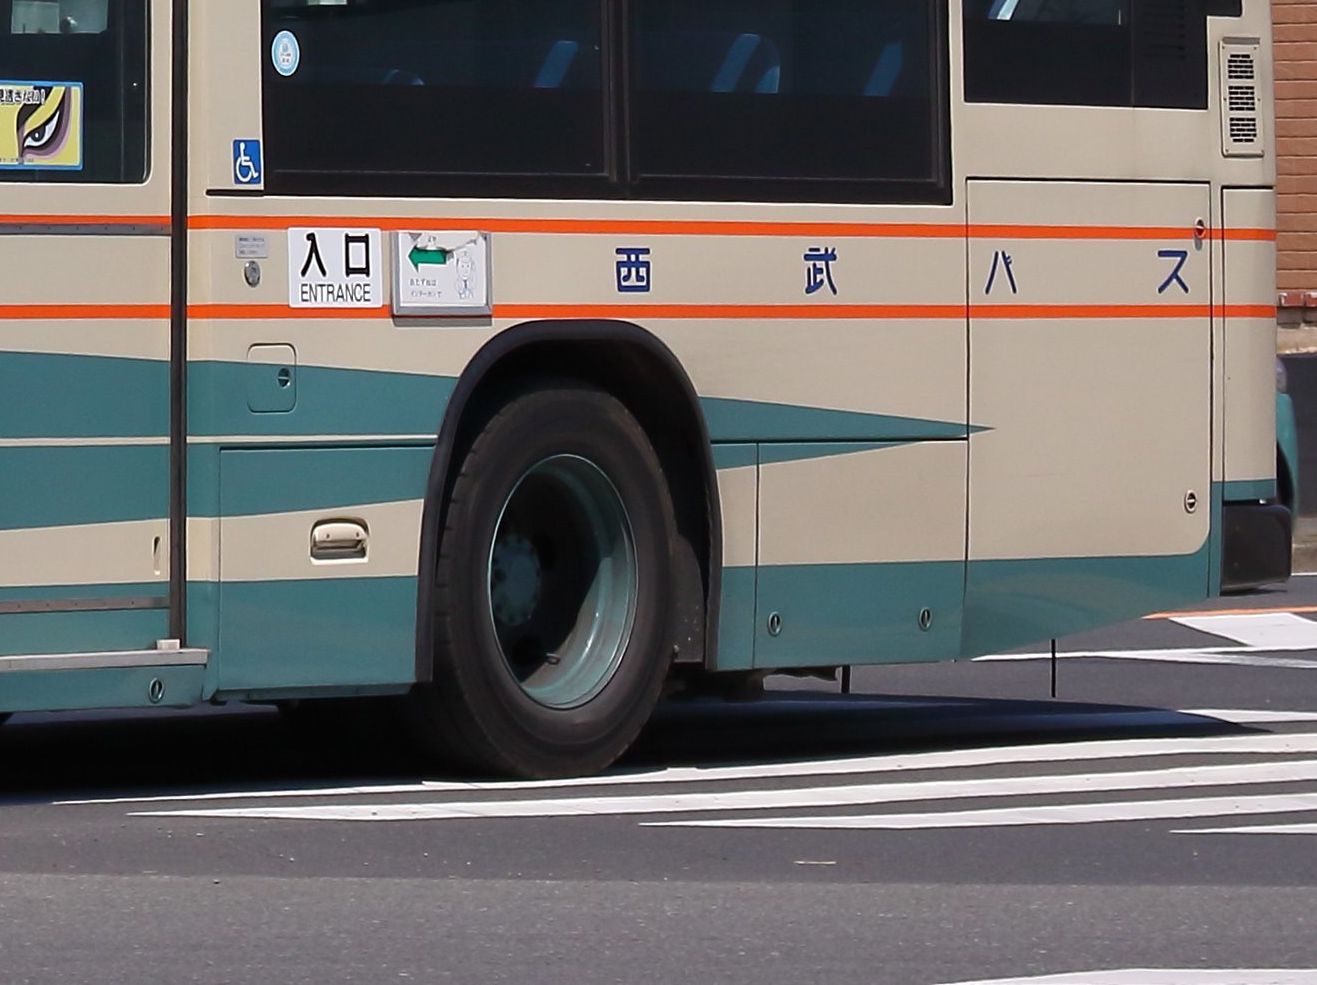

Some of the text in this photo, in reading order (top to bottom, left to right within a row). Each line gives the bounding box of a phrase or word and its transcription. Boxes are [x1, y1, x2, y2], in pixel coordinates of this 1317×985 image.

[300, 232, 370, 278] 入口
[615, 248, 1190, 296] 西武バス
[300, 282, 371, 304] ENTRANCE
